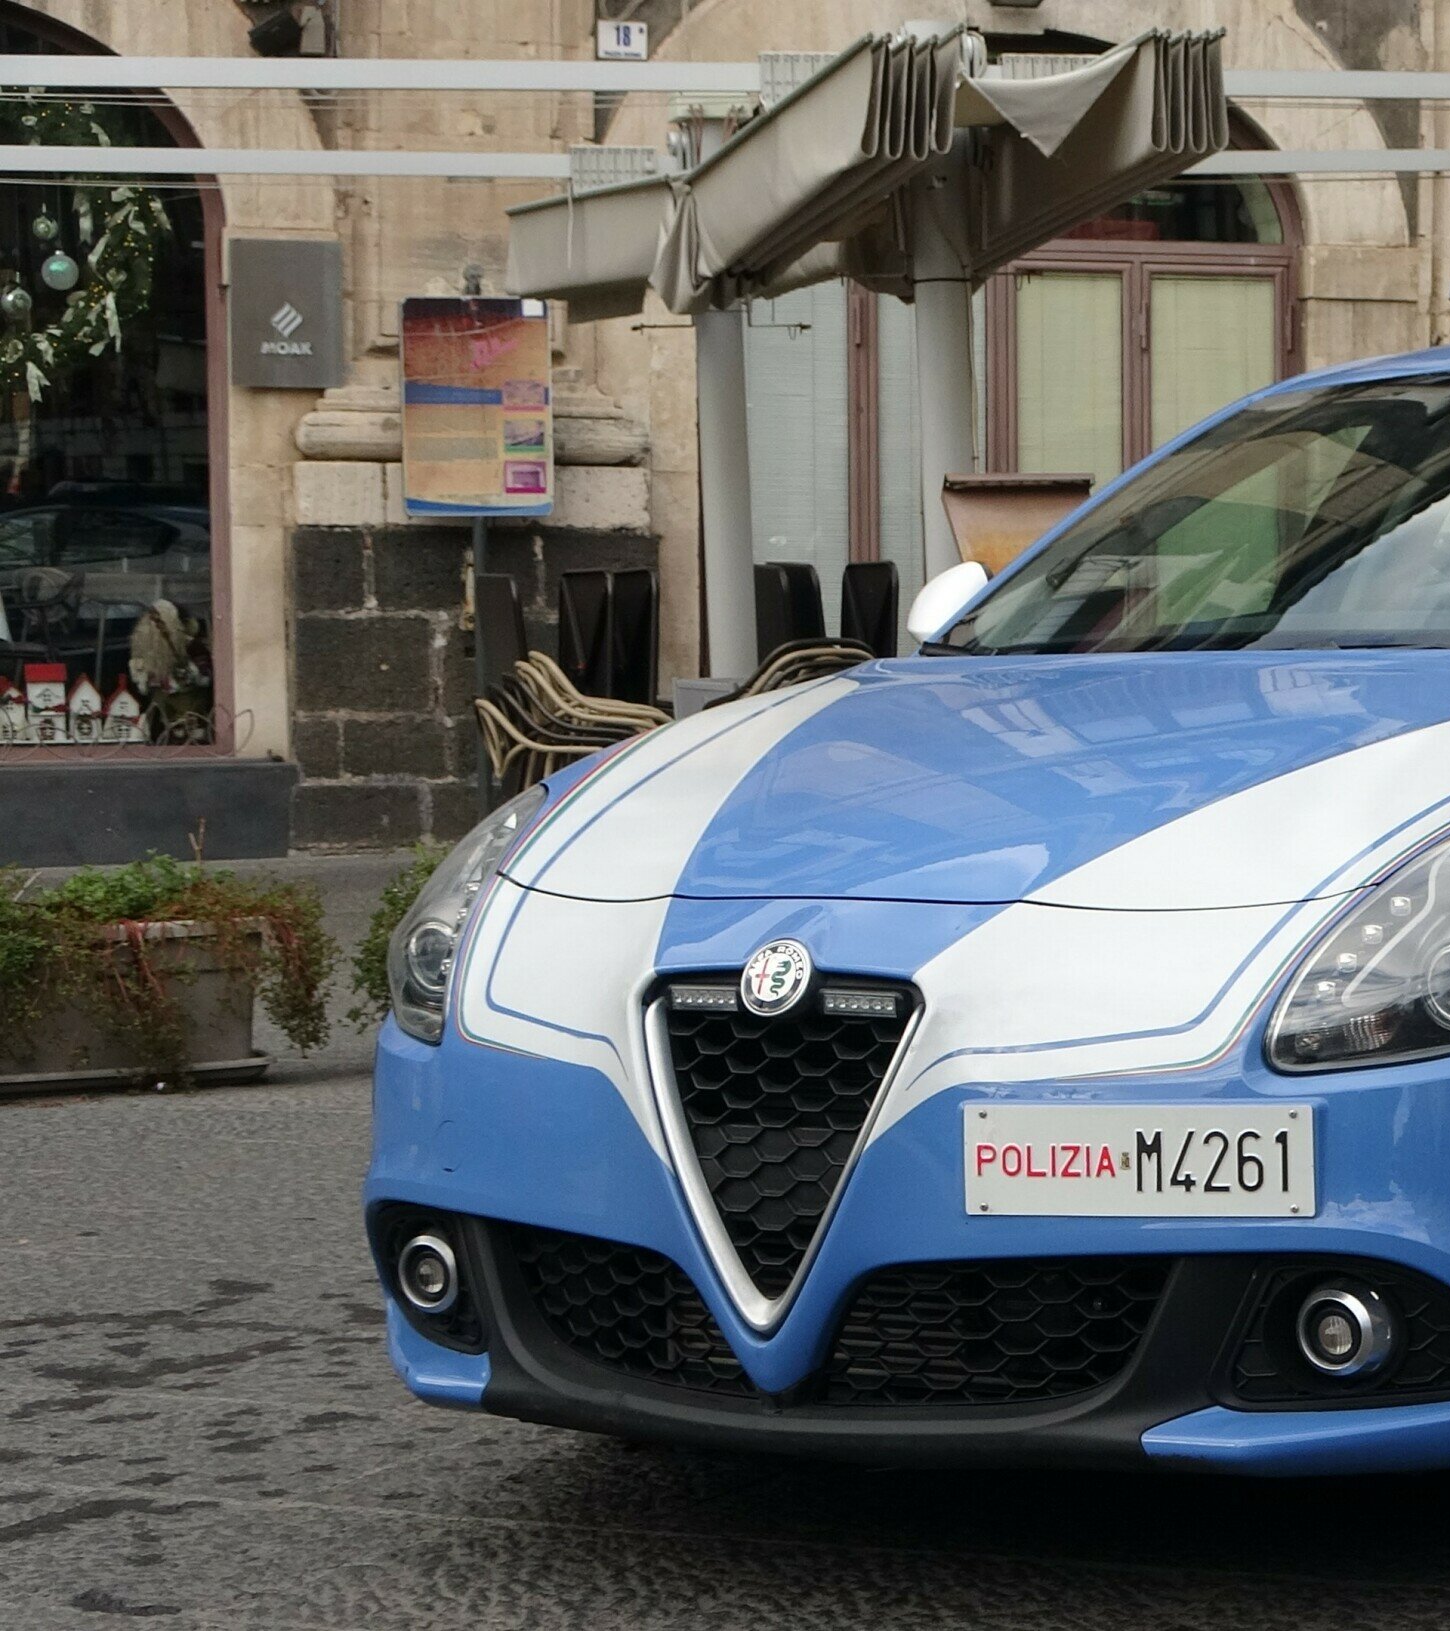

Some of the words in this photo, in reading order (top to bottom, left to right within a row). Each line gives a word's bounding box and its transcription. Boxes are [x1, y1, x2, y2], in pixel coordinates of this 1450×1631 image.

[615, 25, 631, 46] 18
[261, 341, 313, 356] MOAK
[777, 945, 804, 980] ROMEO
[976, 1144, 1116, 1178] POLIZIA
[1135, 1130, 1289, 1193] M4261
